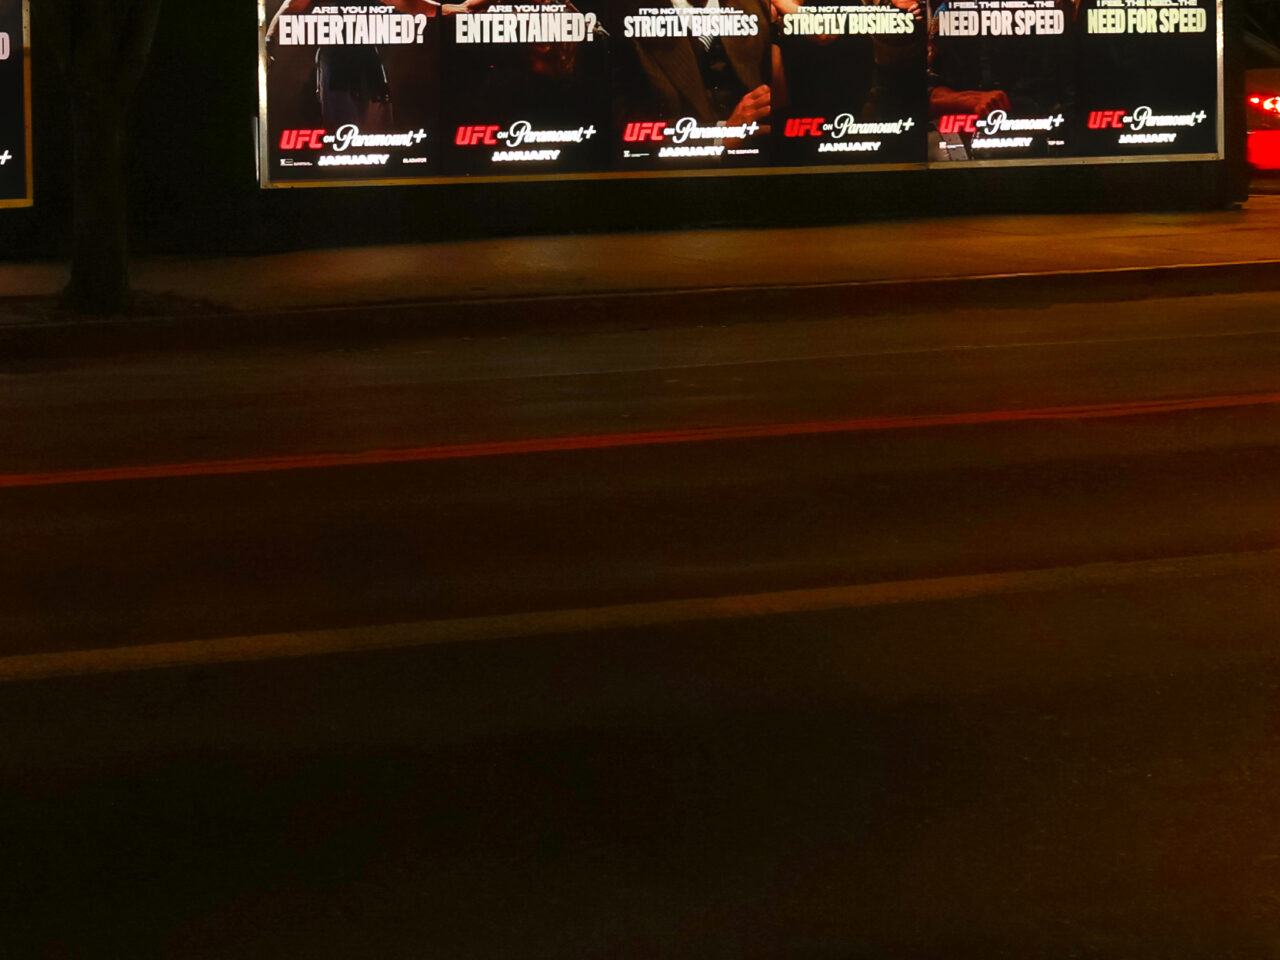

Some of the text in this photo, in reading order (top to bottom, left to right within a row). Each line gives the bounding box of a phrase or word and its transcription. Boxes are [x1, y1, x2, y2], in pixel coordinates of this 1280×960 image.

[341, 6, 368, 14] YOU
[487, 5, 512, 13] ARE
[1088, 8, 1206, 34] NEED FOR SPEED
[279, 14, 427, 45] ENTERTAINED?
[456, 12, 597, 43] ENTERTAINED?
[624, 15, 758, 37] STRICTLY BUSINESS
[784, 13, 915, 35] STRICTLY BUSINESS
[939, 10, 1064, 36] NEED FOR SPEED
[624, 122, 667, 142] UFC
[673, 117, 759, 143] Paramount+
[784, 118, 825, 137] UFC
[831, 113, 915, 138] Paramount+
[939, 115, 979, 133] UFC
[984, 110, 1064, 135] Paramount+
[1088, 111, 1126, 129] UFC
[1131, 106, 1207, 131] Paramount+
[280, 124, 427, 152] UFC ON Paramount+
[456, 125, 500, 145] UFC
[507, 121, 596, 147] Paramount+
[971, 137, 1033, 148] JANUARY
[492, 150, 560, 162] JANUARY
[659, 146, 725, 158] JANUARY
[818, 142, 881, 152] JANUARY
[318, 154, 390, 166] JANUARY
